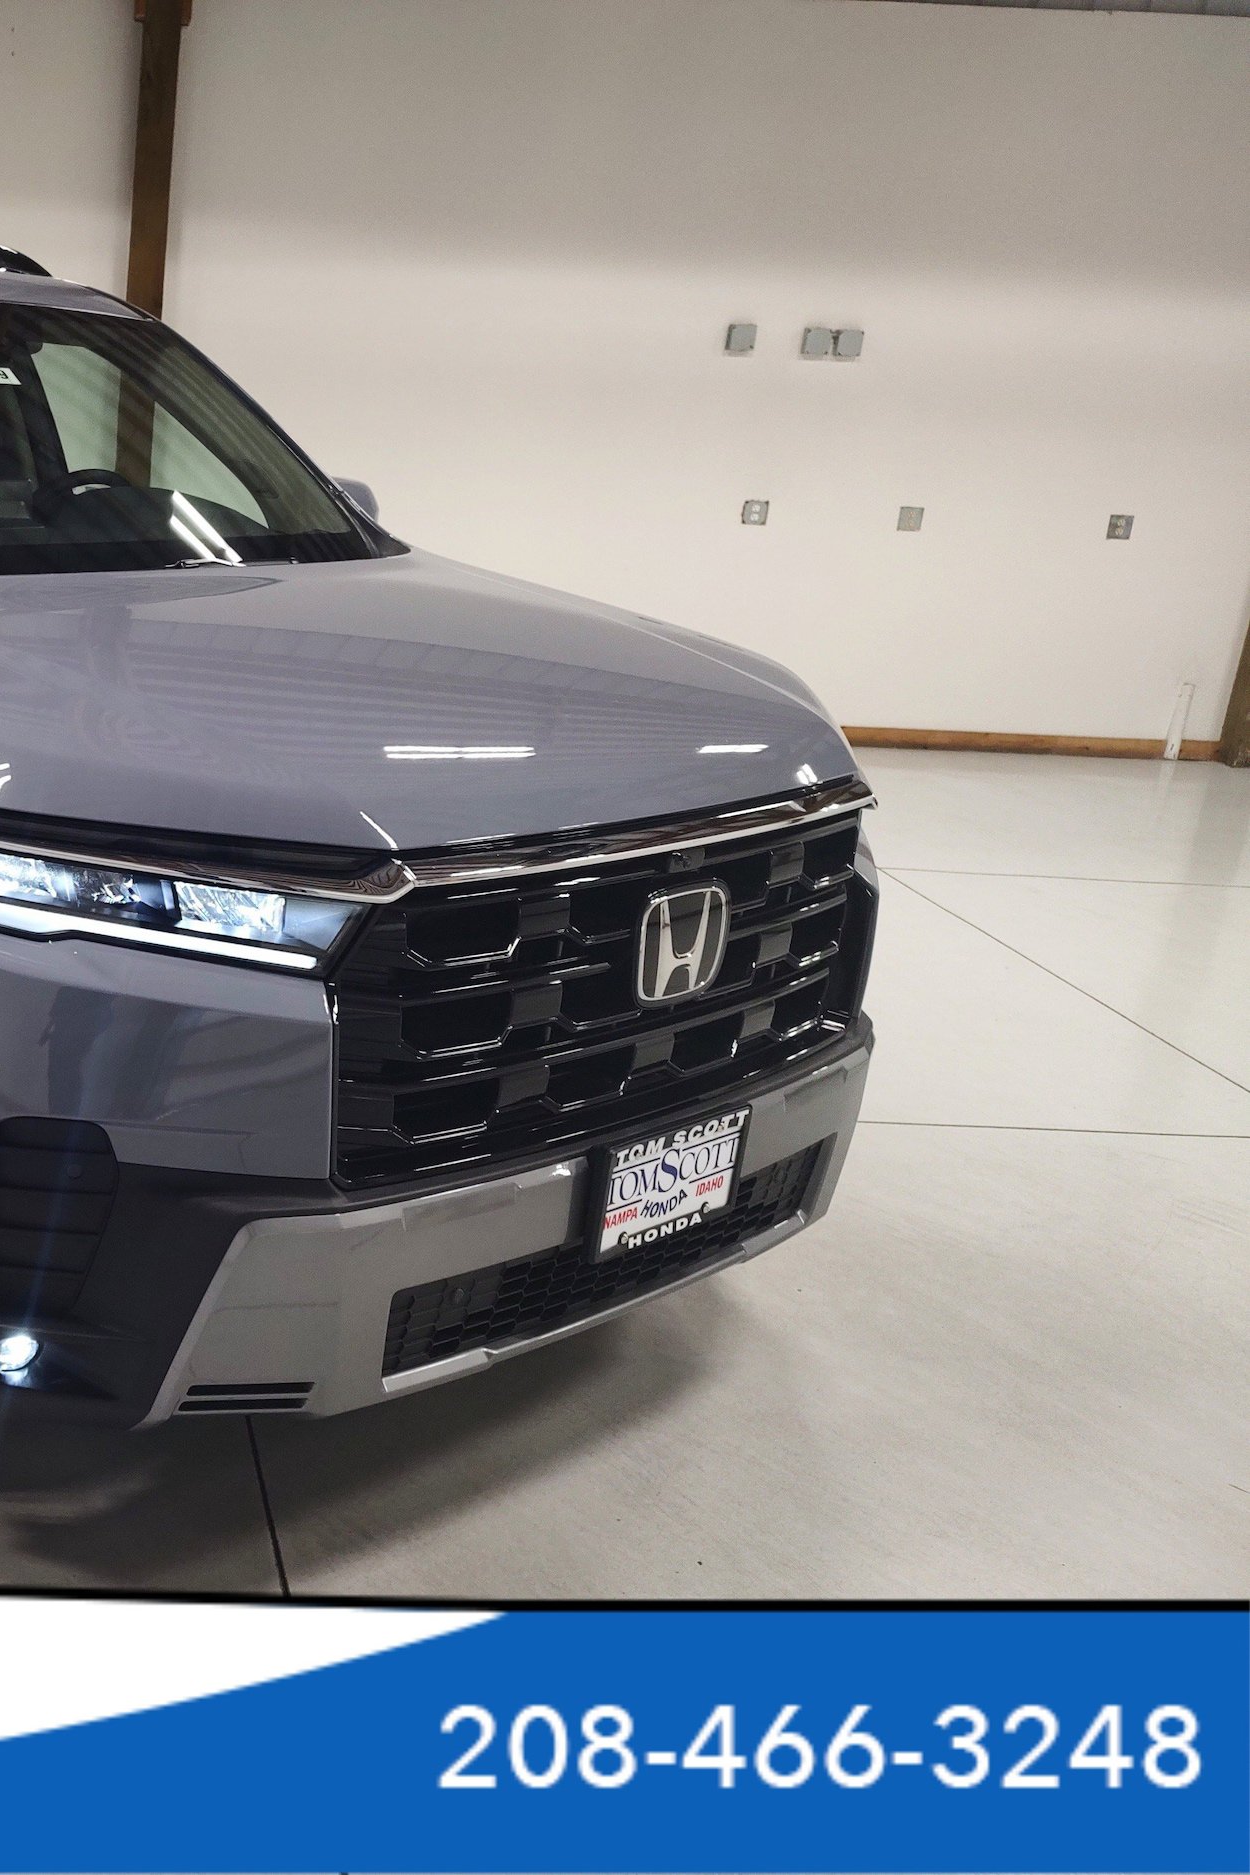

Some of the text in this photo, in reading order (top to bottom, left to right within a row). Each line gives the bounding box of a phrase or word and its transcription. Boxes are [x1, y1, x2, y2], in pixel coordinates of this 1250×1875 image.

[615, 1109, 750, 1168] TOM SCOTT
[695, 1174, 724, 1197] IDAHO
[603, 1206, 638, 1230] NAMPA
[640, 1188, 688, 1218] HONDA
[627, 1212, 702, 1249] HONDA
